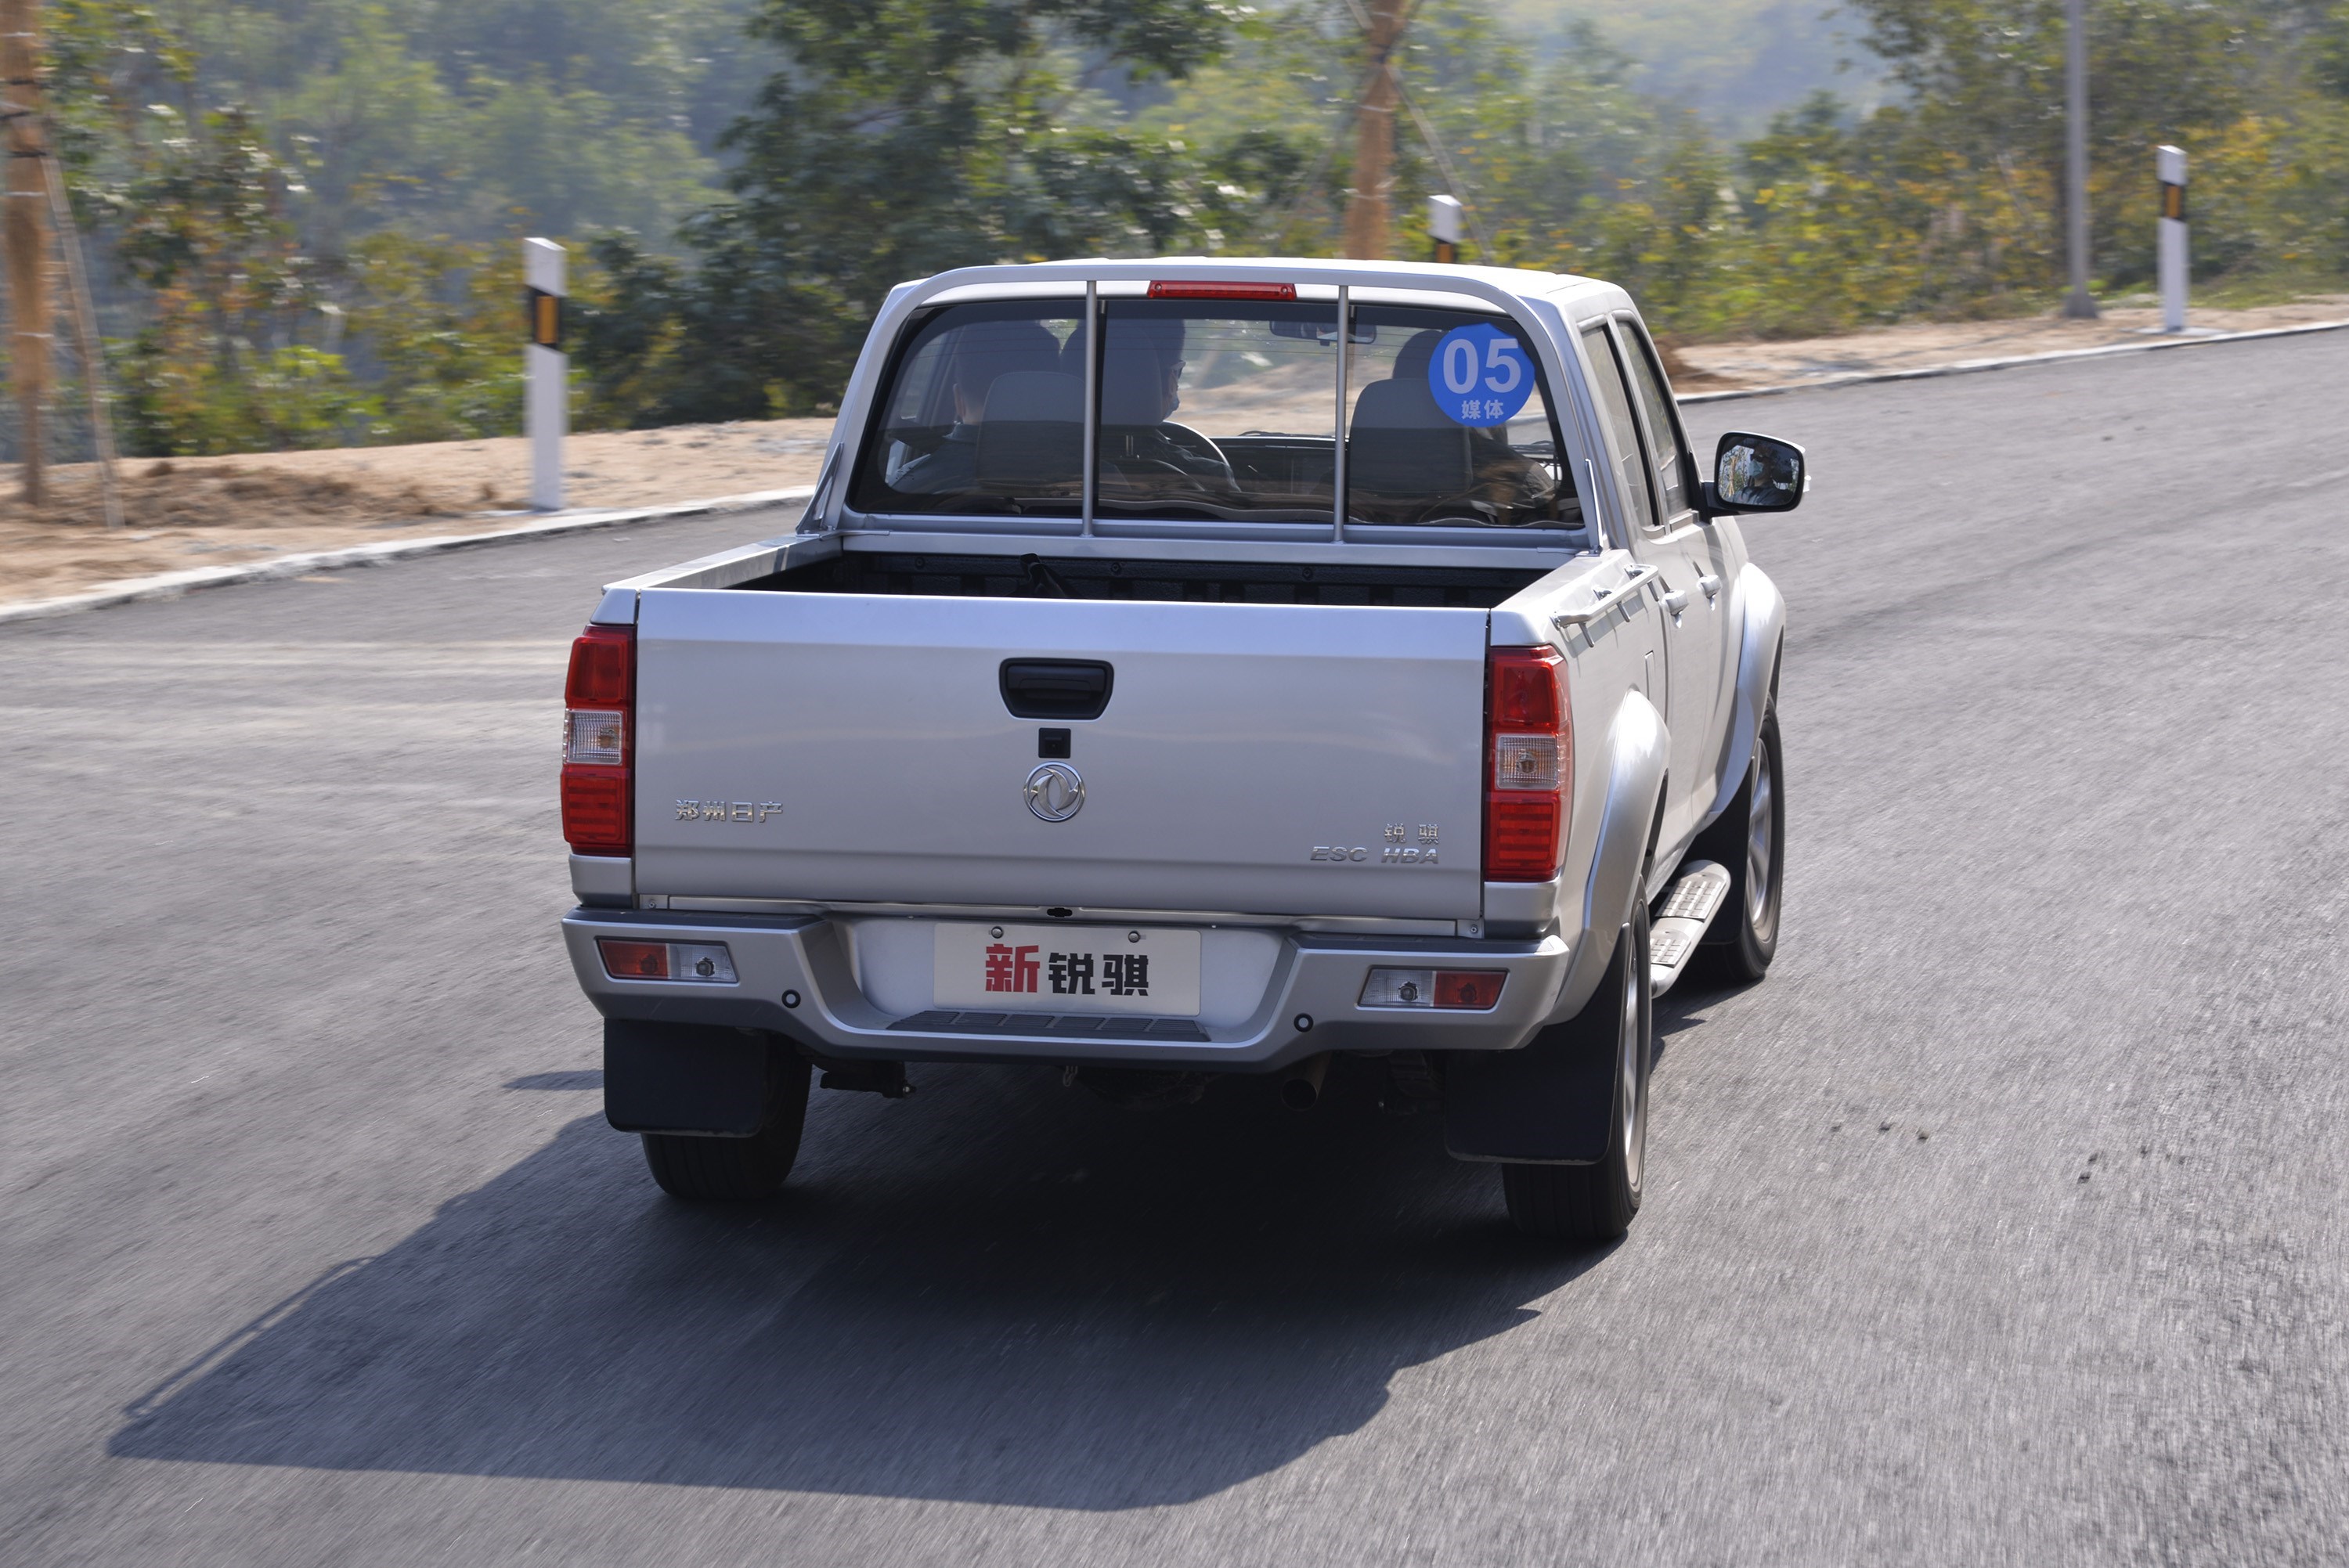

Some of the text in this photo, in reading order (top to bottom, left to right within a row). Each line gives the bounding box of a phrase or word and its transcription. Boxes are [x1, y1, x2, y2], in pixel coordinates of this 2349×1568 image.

[1443, 338, 1521, 394] 05
[1461, 399, 1504, 420] 媒体
[675, 799, 782, 823] 郑州日产
[1310, 845, 1439, 864] ESC HBA
[985, 943, 1149, 996] 新锐骐
